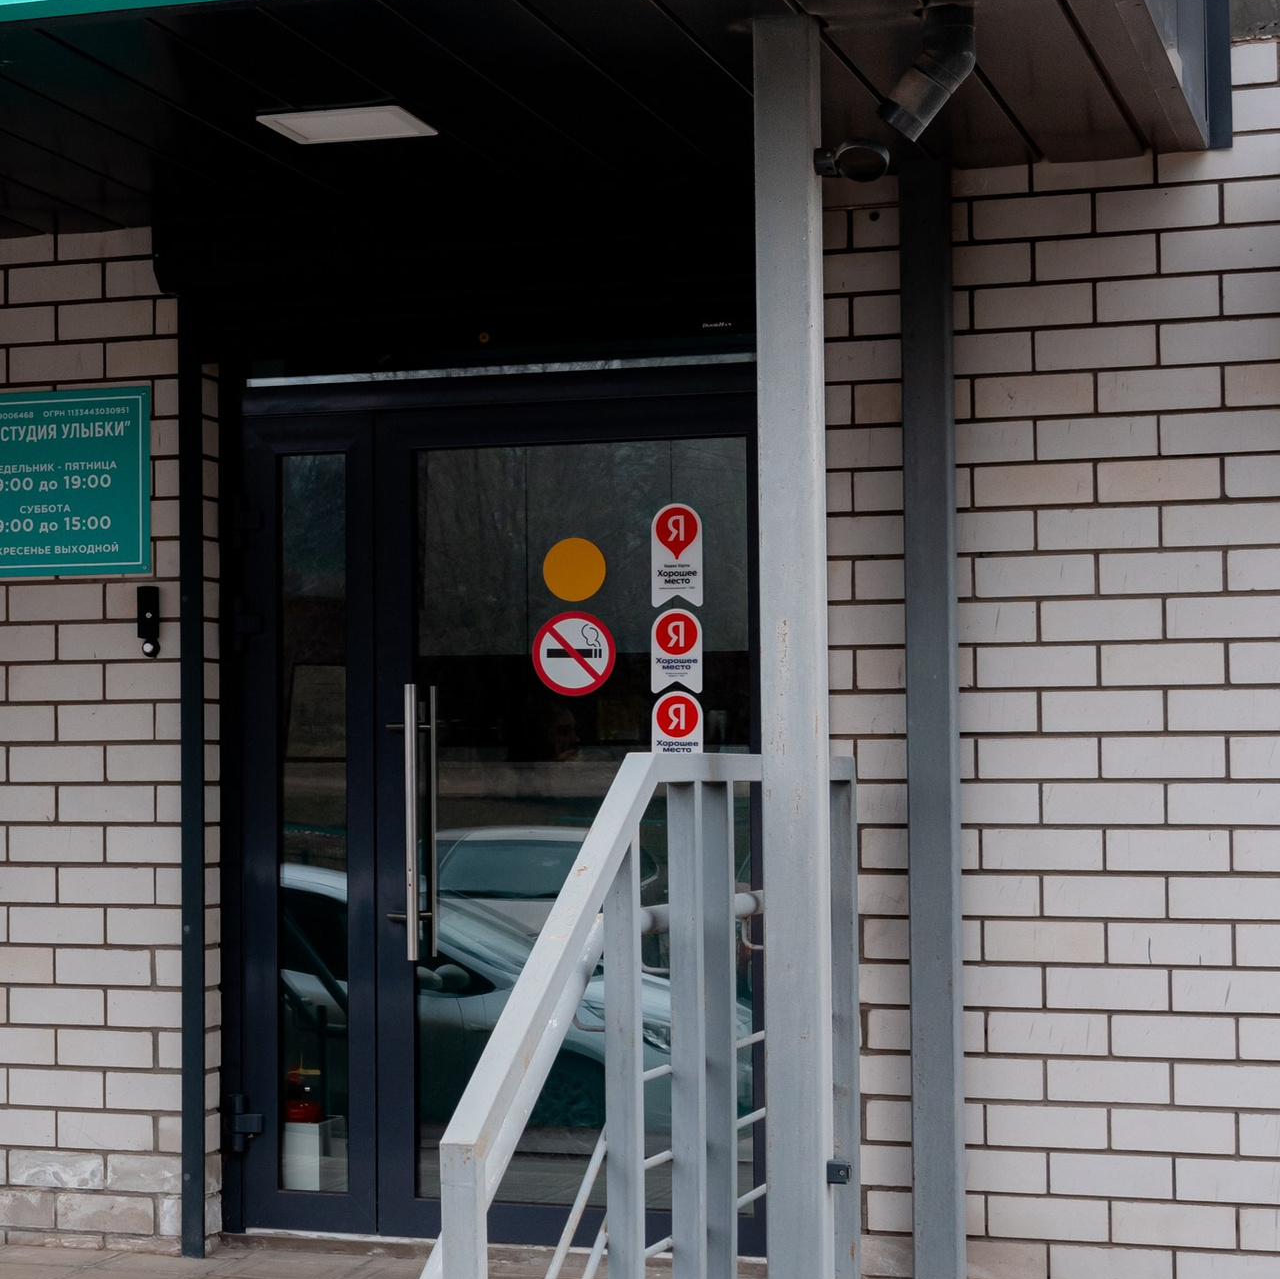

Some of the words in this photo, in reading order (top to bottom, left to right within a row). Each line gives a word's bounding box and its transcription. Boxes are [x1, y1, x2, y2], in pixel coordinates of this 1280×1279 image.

[65, 460, 118, 471] ПЯТНИЦА
[38, 480, 58, 492] до
[63, 474, 112, 489] 19:00
[19, 504, 71, 514] СУББОТА
[38, 521, 59, 533] до
[63, 515, 112, 531] 15:00
[667, 515, 685, 542] Я
[54, 541, 119, 554] ВЫХОДНОЙ
[657, 569, 698, 577] Хорошее
[667, 621, 685, 647] Я
[668, 703, 686, 730] Я
[656, 739, 699, 747] Хорошее
